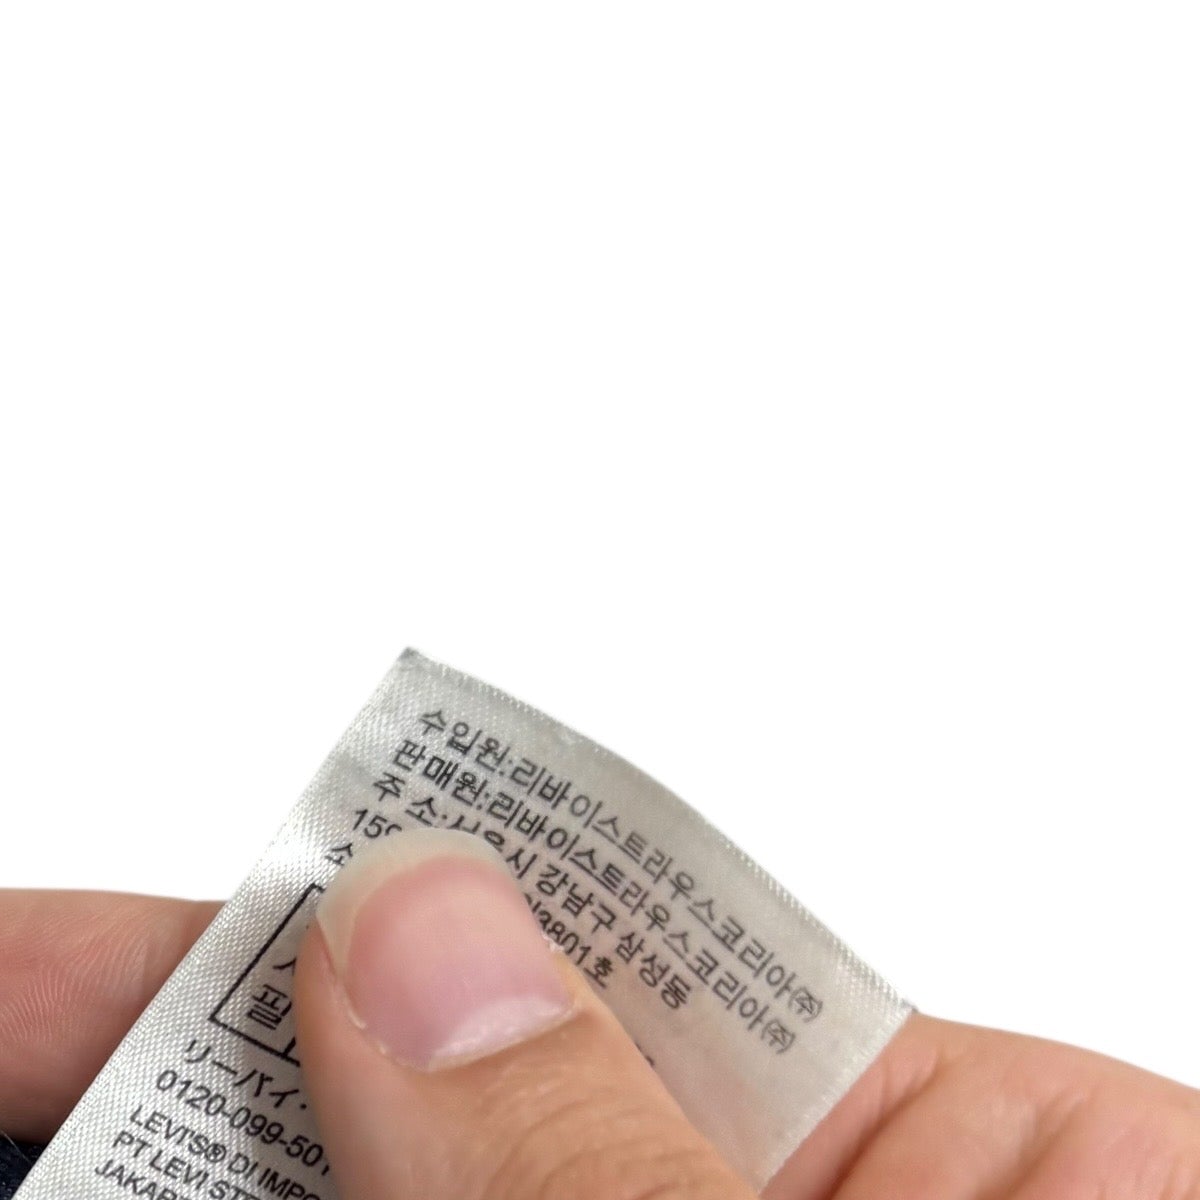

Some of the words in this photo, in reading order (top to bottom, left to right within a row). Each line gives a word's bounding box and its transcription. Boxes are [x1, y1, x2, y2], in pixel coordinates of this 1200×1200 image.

[535, 863, 617, 934] 강남구
[614, 931, 691, 1010] 삼성동
[112, 1130, 152, 1160] PT
[150, 1150, 210, 1191] LEVI
[227, 1152, 259, 1177] DI
